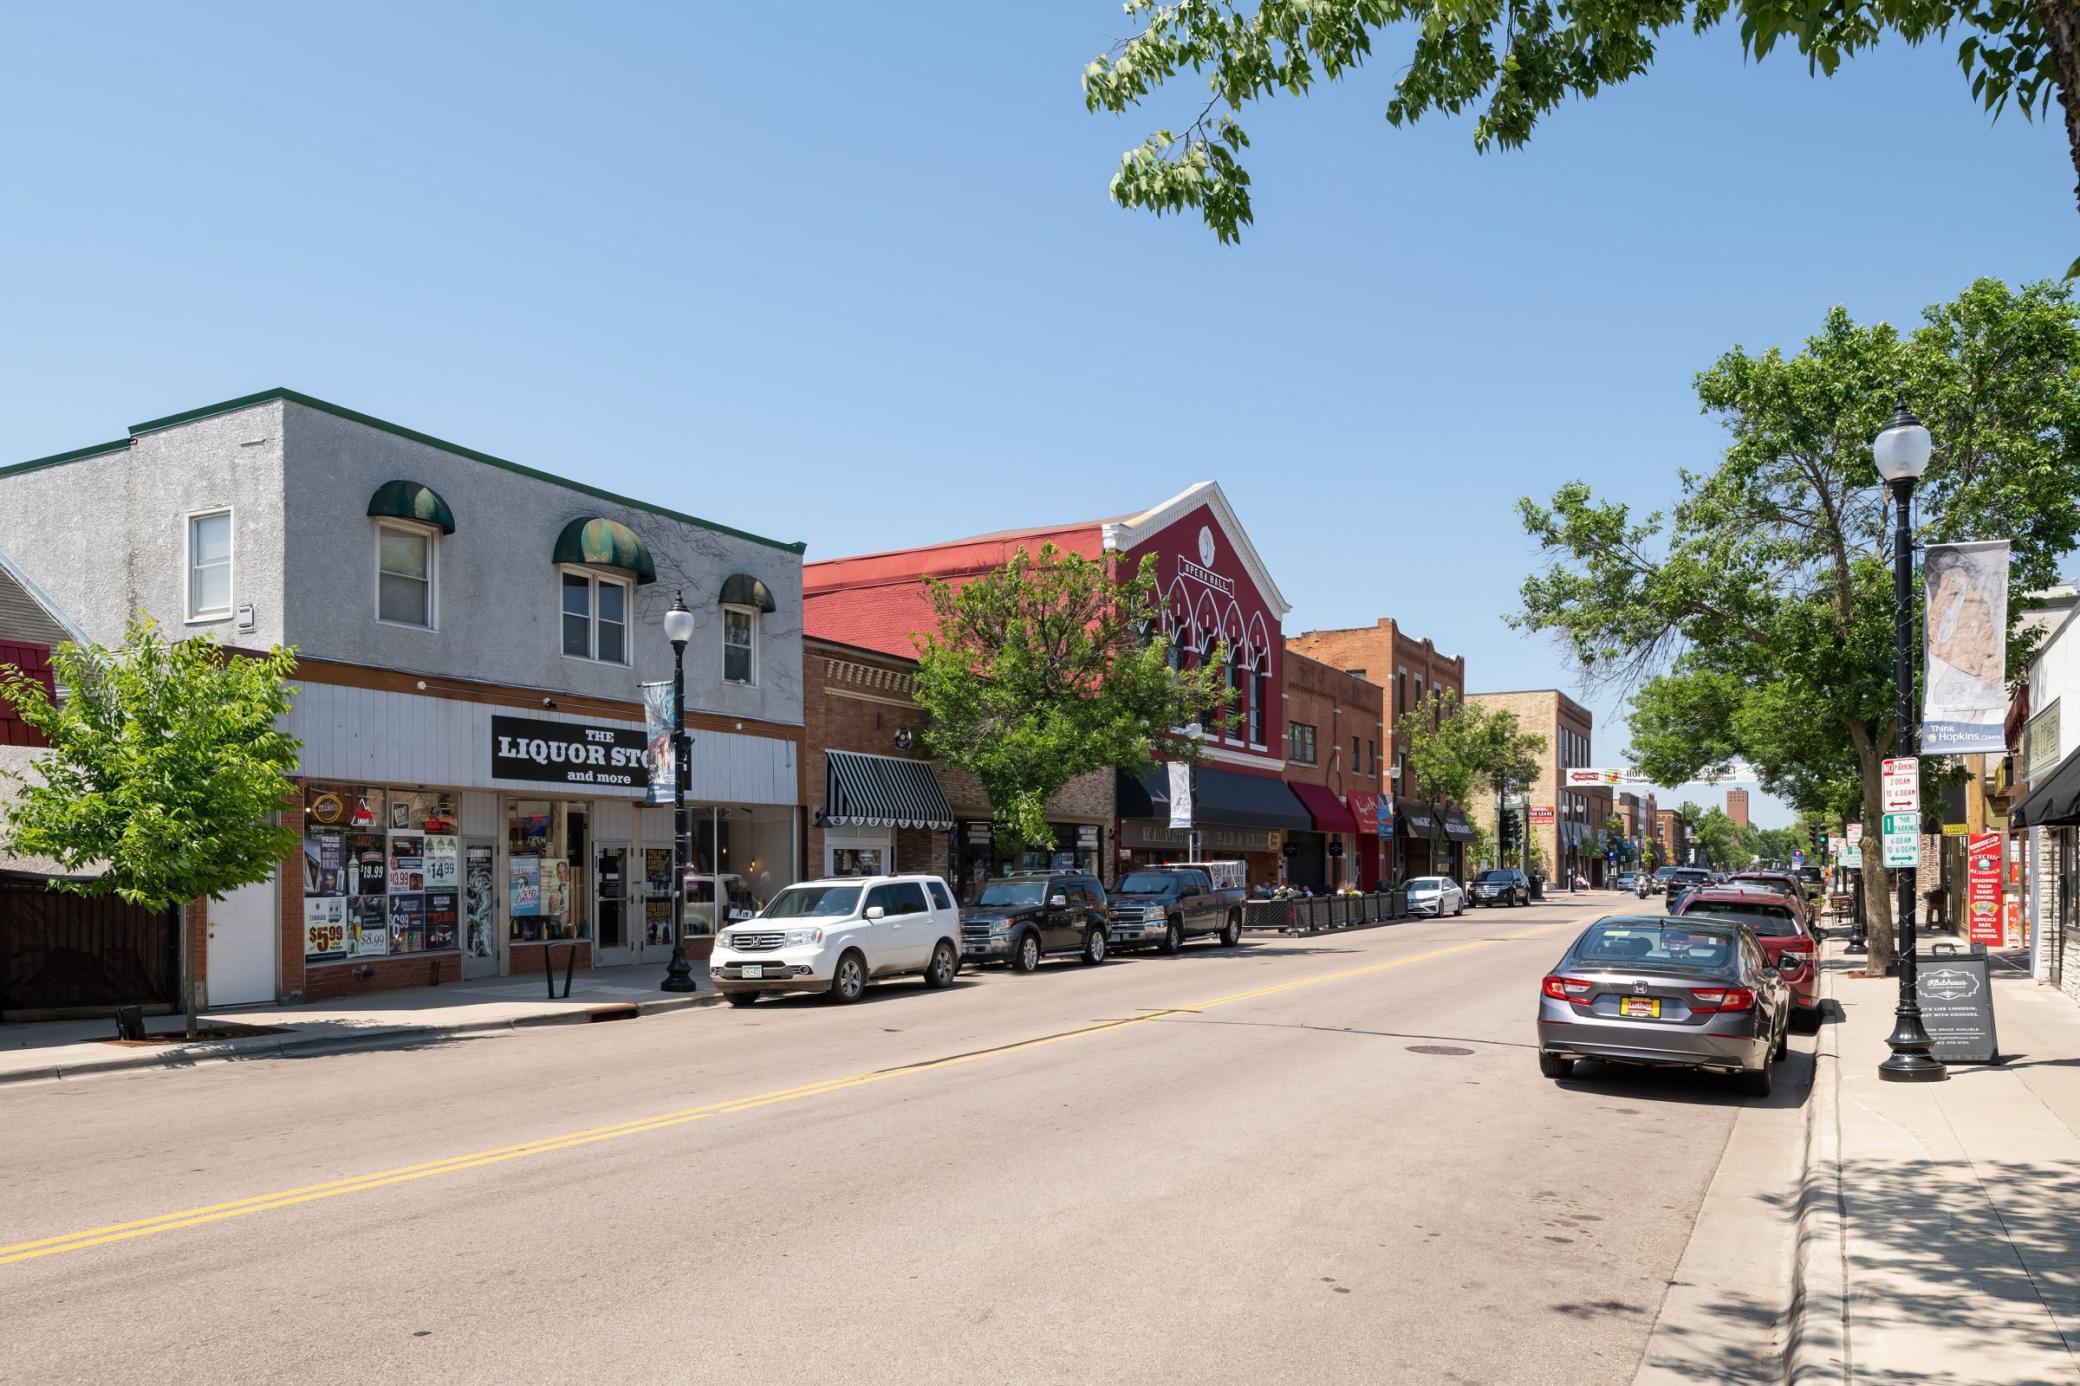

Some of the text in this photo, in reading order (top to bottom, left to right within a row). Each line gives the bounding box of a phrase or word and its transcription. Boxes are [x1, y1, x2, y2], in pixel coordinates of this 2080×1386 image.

[1185, 564, 1229, 591] OPERA HALL
[1930, 724, 1955, 733] Think
[585, 729, 615, 744] THE
[1938, 732, 2001, 744] Hopkins.com
[498, 736, 606, 766] LIQUOR
[1883, 763, 1916, 774] NO PARKING
[567, 771, 632, 785] and more
[527, 835, 546, 844] OPEN
[1969, 854, 2001, 862] PSYCHIC
[360, 864, 383, 879] $19.99
[390, 871, 409, 887] $13.99
[360, 933, 385, 946] $8.99
[1628, 1001, 1652, 1010] Luther
